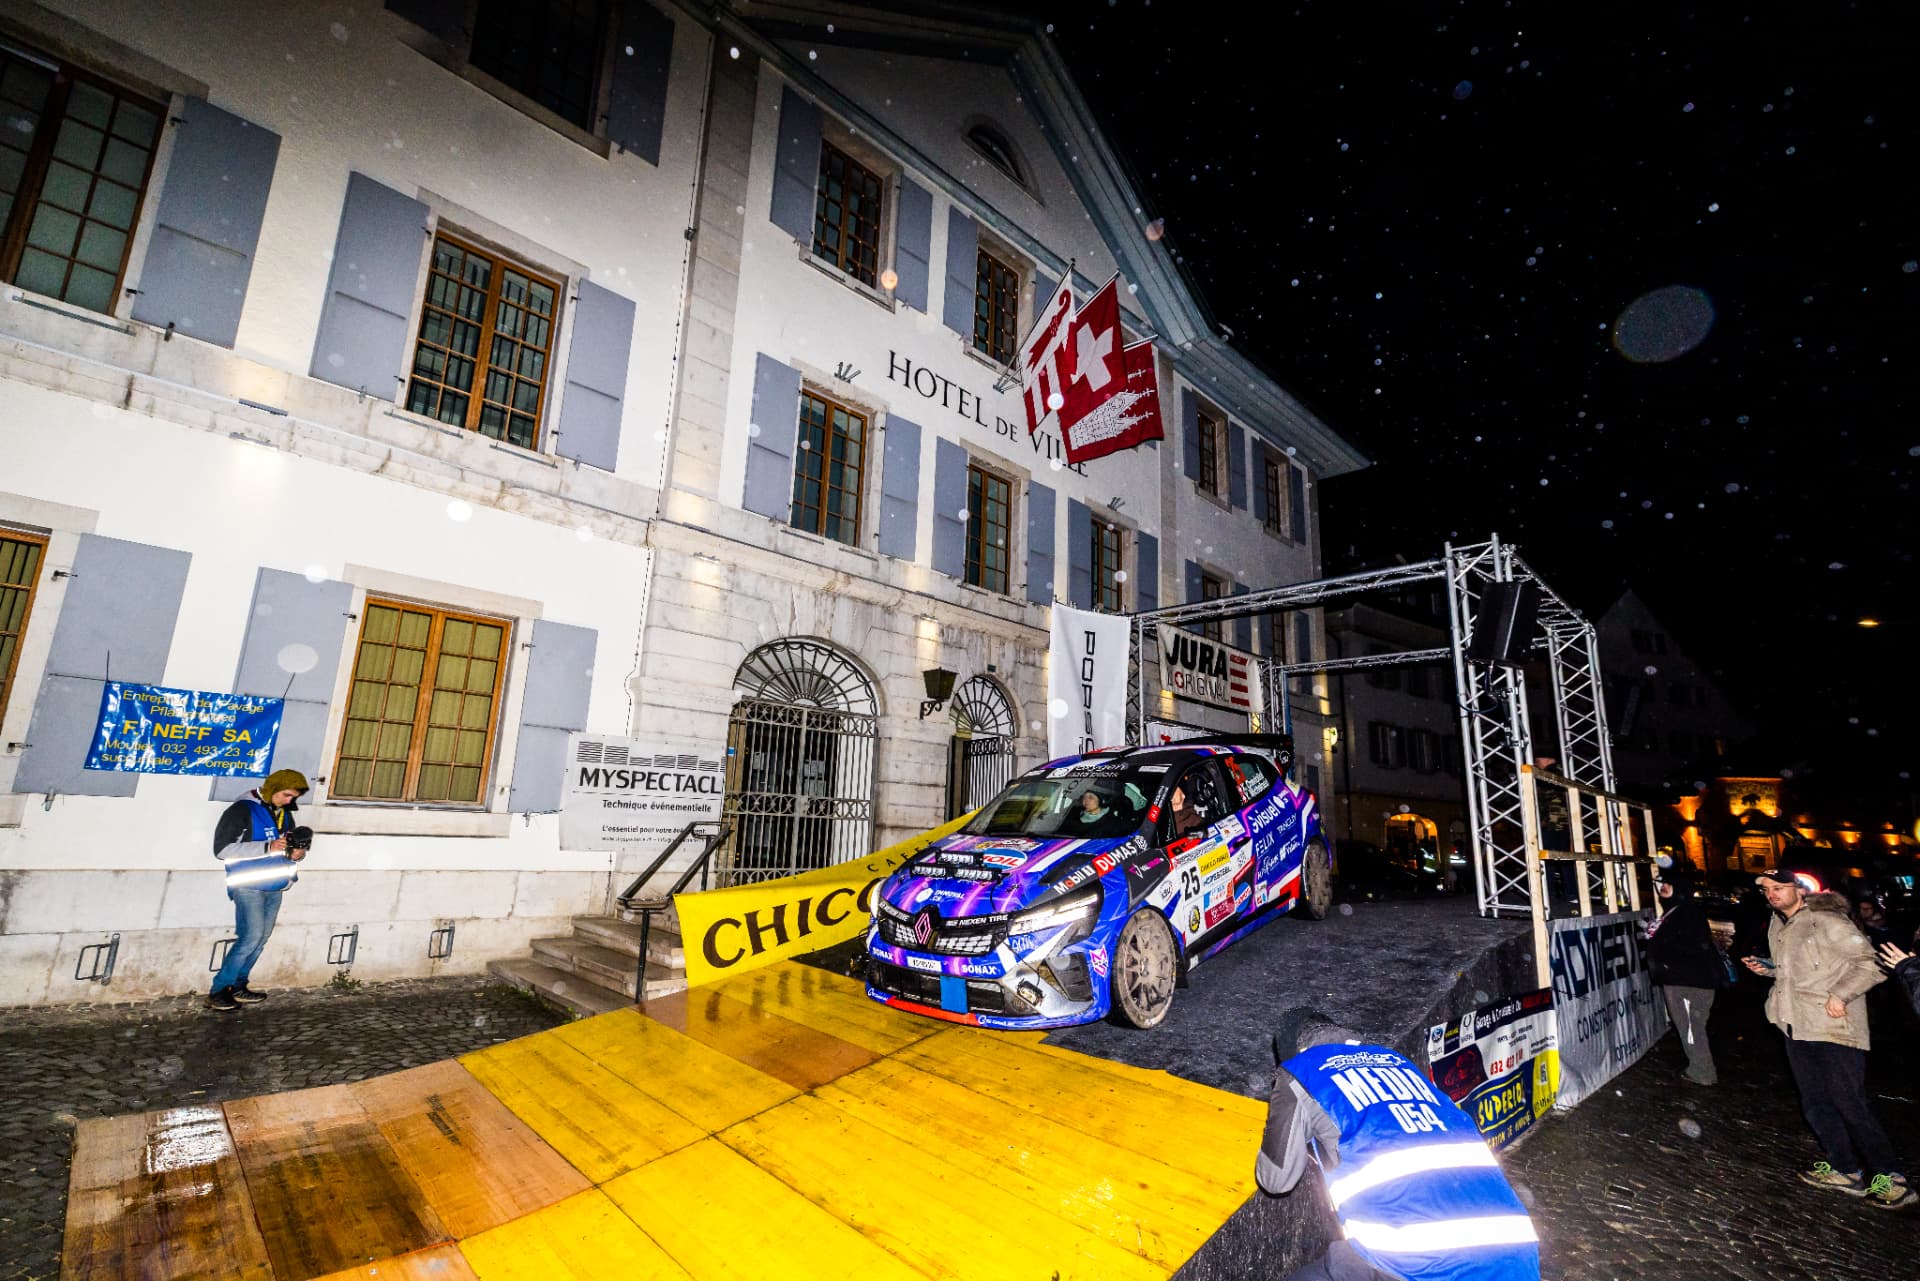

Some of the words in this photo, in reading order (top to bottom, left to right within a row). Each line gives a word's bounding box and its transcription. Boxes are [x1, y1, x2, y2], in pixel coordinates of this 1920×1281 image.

[887, 350, 988, 428] HOTEL
[996, 416, 1018, 443] DE
[1165, 633, 1228, 681] JURA
[123, 689, 188, 707] Entrep
[217, 699, 264, 715] avage
[152, 722, 213, 741] NEFF
[222, 729, 252, 744] SA
[161, 743, 187, 754] 032
[193, 745, 219, 757] 493
[224, 747, 240, 757] 23
[246, 748, 263, 759] 4
[101, 753, 173, 767] succuale
[196, 757, 260, 773] Porrentru
[602, 799, 648, 811] Technique
[650, 801, 712, 813] événementielle
[602, 824, 639, 833] L'essentiel
[1095, 842, 1137, 872] DUMAS
[1053, 870, 1086, 895] Mobil
[1181, 866, 1201, 901] 25
[959, 917, 987, 927] NEXEN
[988, 914, 1009, 923] TIRE
[872, 947, 893, 961] SONAX
[961, 963, 998, 976] SONAX
[1330, 1067, 1441, 1113] MEDIA
[1387, 1102, 1449, 1134] 054
